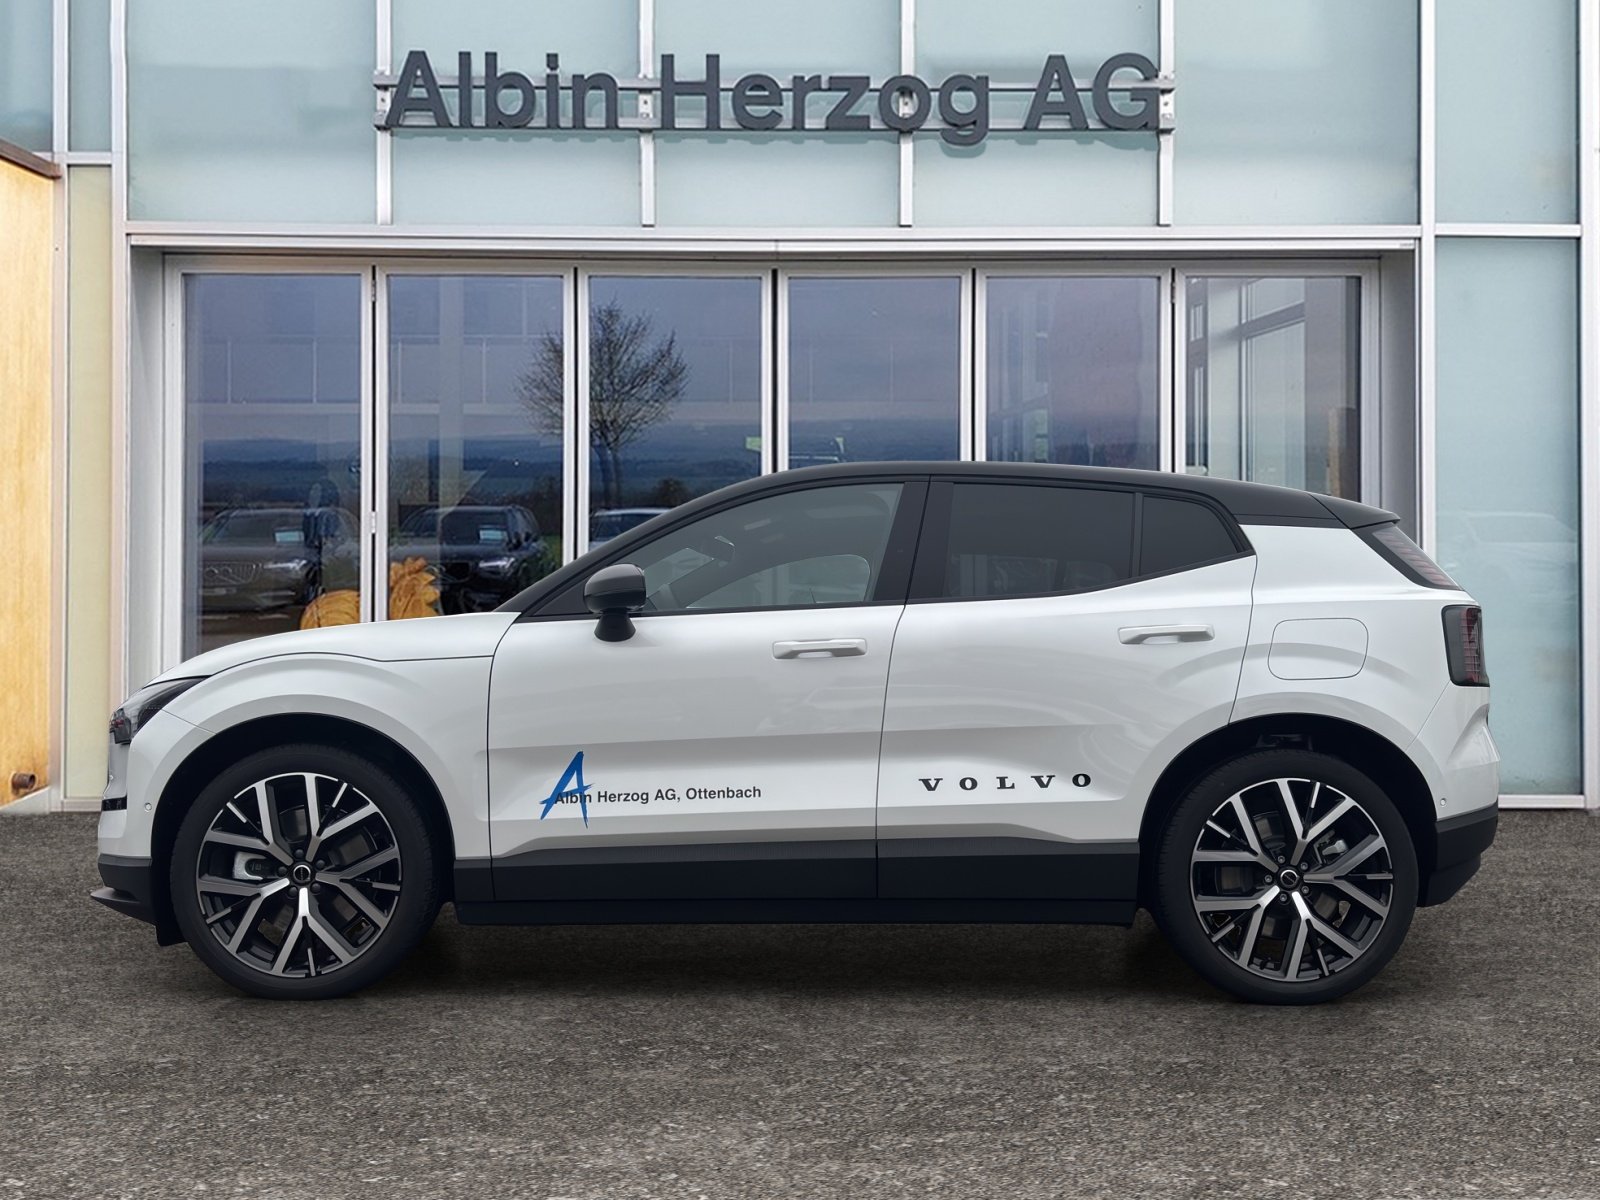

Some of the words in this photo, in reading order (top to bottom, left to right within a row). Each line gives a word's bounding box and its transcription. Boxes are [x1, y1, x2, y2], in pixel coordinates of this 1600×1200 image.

[386, 50, 619, 129] Albin
[661, 53, 990, 146] Herzog
[1023, 53, 1160, 130] AG
[918, 773, 1092, 792] VOLVO
[554, 791, 592, 804] Albin
[597, 790, 649, 804] Herzog
[654, 788, 681, 803] AG,
[686, 786, 762, 800] Ottenbach
